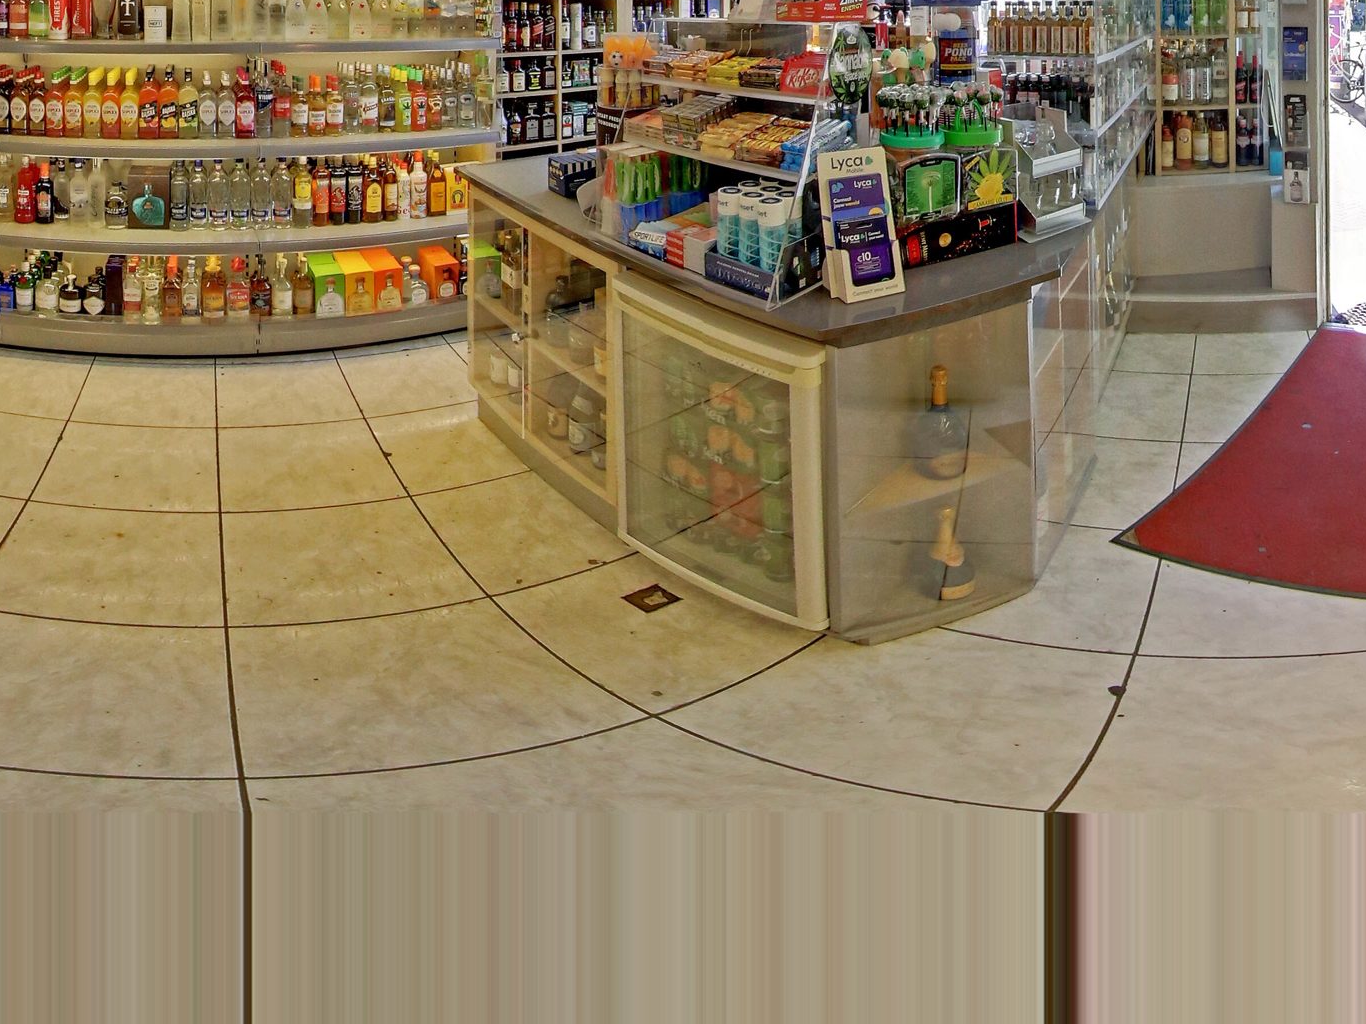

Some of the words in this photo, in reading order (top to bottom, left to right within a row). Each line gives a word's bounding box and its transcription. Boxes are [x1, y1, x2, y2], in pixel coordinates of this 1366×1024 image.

[841, 3, 862, 12] ENERGY
[788, 67, 820, 88] KitKat
[831, 156, 863, 172] Lyca
[854, 178, 872, 189] Lyca
[841, 233, 861, 243] Lyca
[857, 251, 871, 262] €10
